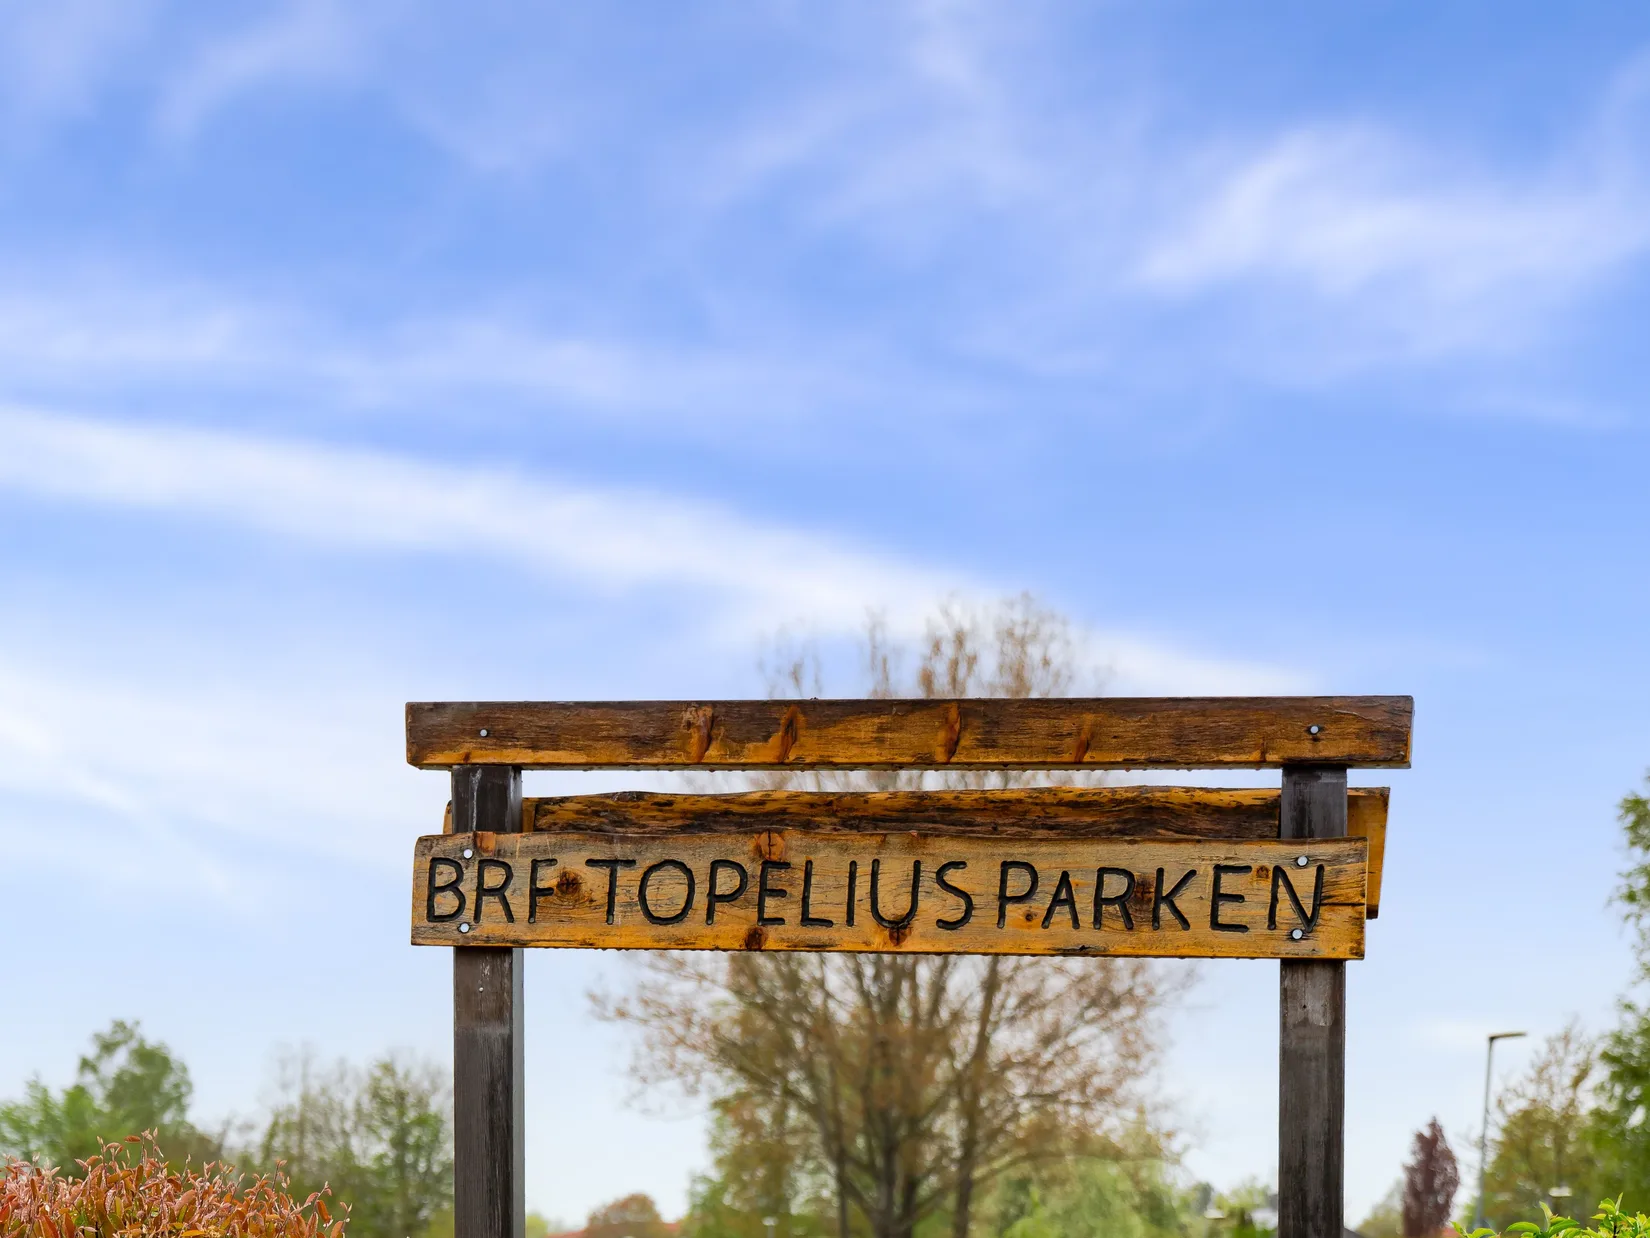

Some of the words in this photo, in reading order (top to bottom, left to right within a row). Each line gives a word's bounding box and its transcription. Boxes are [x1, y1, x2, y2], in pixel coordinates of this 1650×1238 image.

[426, 857, 558, 924] BRF
[585, 858, 974, 931] TOPELIUS
[996, 860, 1325, 933] PARKEN
